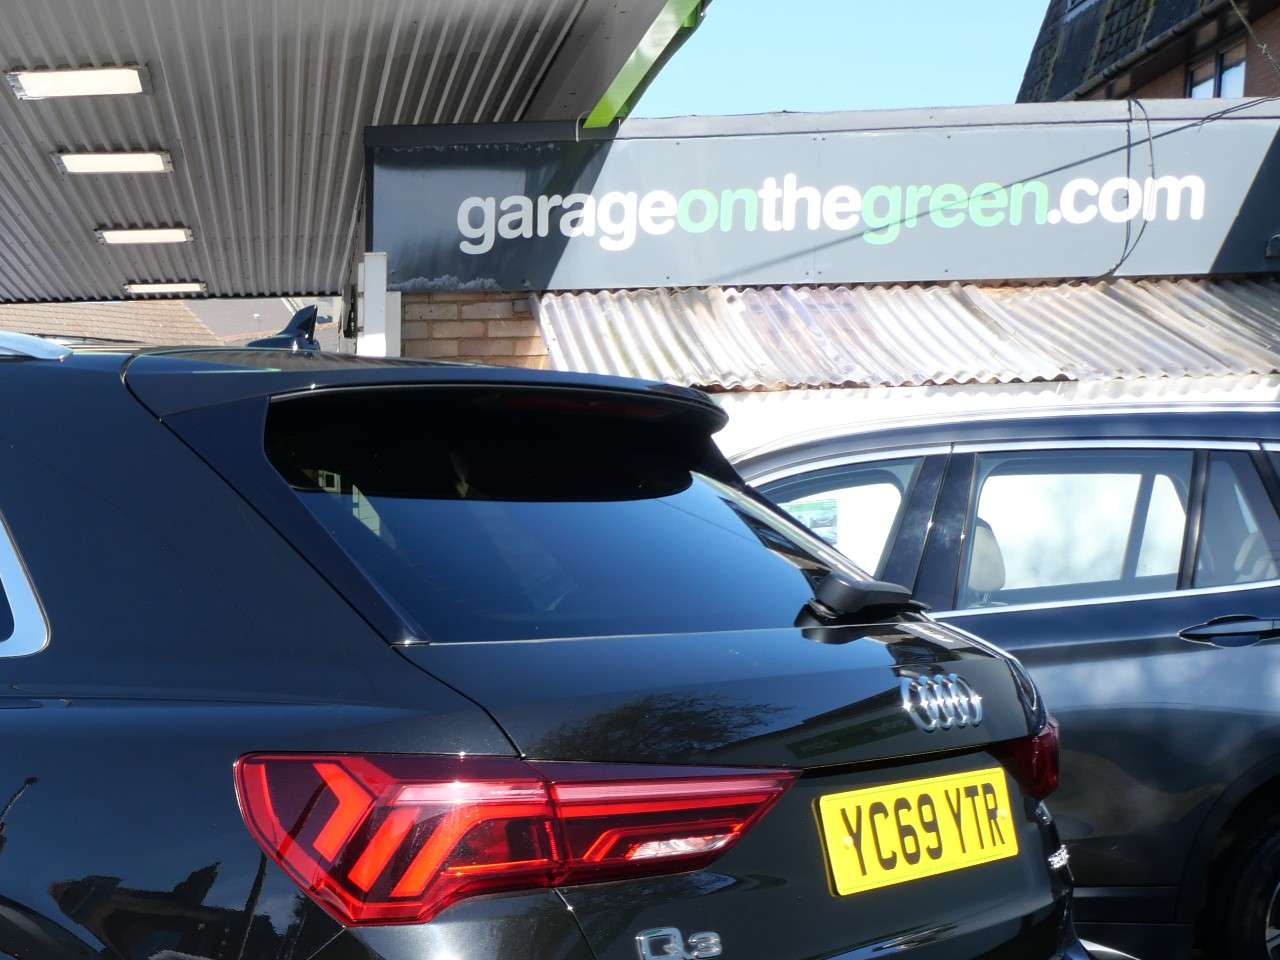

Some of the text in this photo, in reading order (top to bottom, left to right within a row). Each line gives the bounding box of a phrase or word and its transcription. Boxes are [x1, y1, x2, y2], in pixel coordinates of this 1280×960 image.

[457, 173, 1205, 254] garageonthegreen.com
[840, 782, 1006, 876] YC69 YTR
